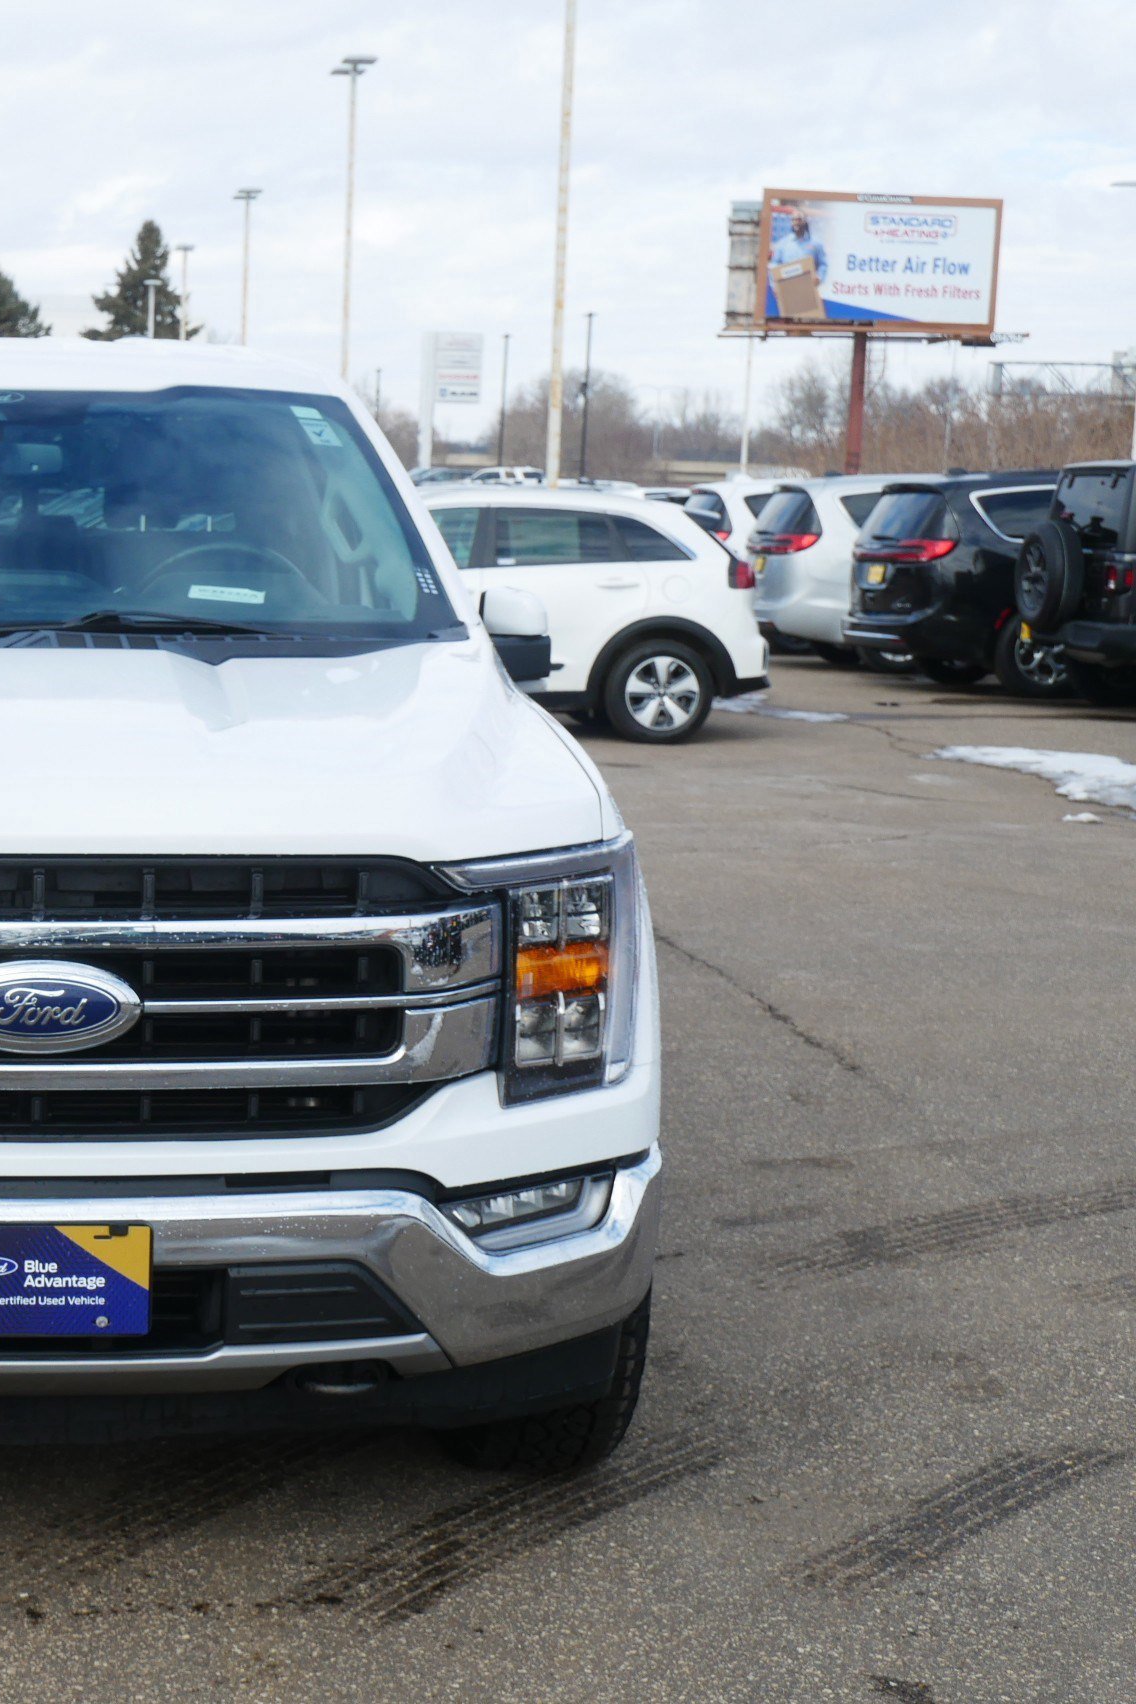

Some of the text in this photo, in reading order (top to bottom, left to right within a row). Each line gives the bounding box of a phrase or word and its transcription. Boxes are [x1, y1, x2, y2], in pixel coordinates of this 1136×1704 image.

[846, 254, 971, 276] Better Air Flow
[831, 281, 982, 301] Starts With Fresh Filters
[24, 1259, 58, 1273] Blue
[23, 1275, 106, 1290] Advantage
[38, 1295, 66, 1306] Used
[67, 1296, 105, 1306] Vehicle
